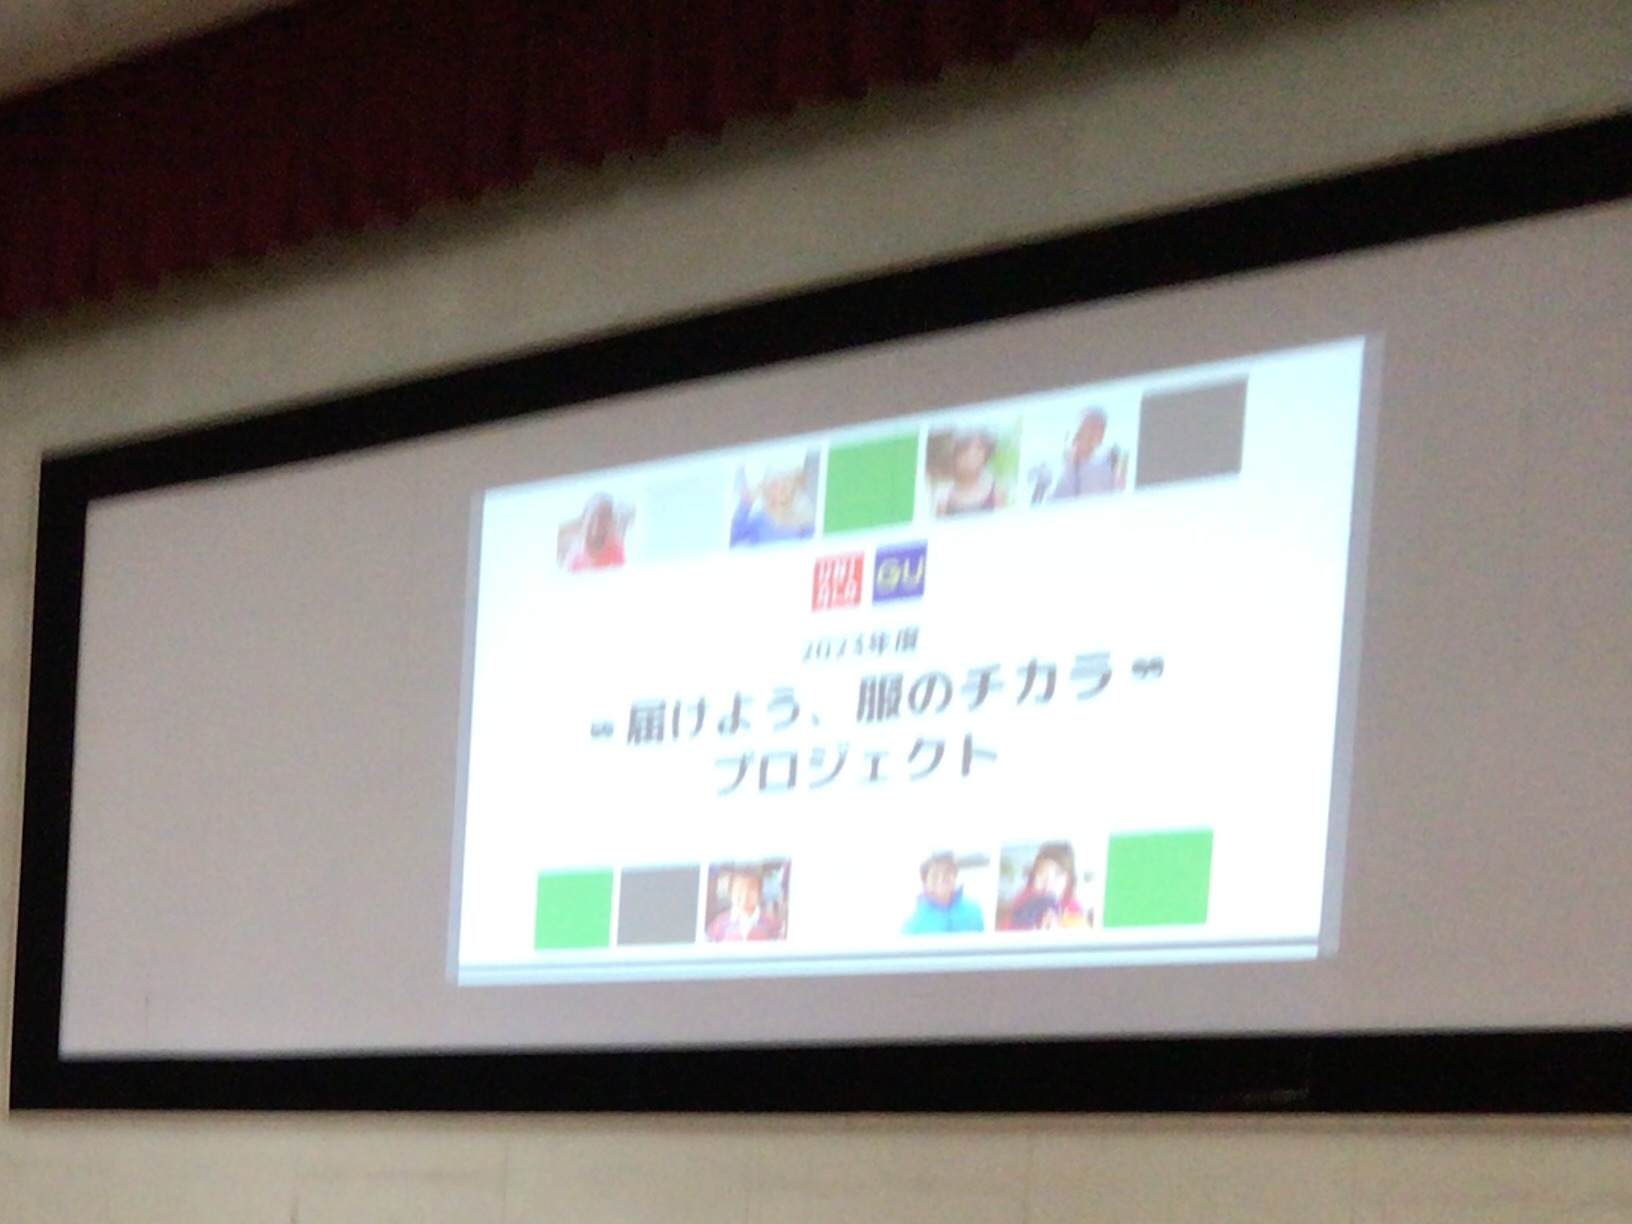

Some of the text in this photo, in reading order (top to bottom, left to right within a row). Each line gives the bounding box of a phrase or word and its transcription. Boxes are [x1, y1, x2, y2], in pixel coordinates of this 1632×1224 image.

[713, 732, 998, 796] プロジェクト
